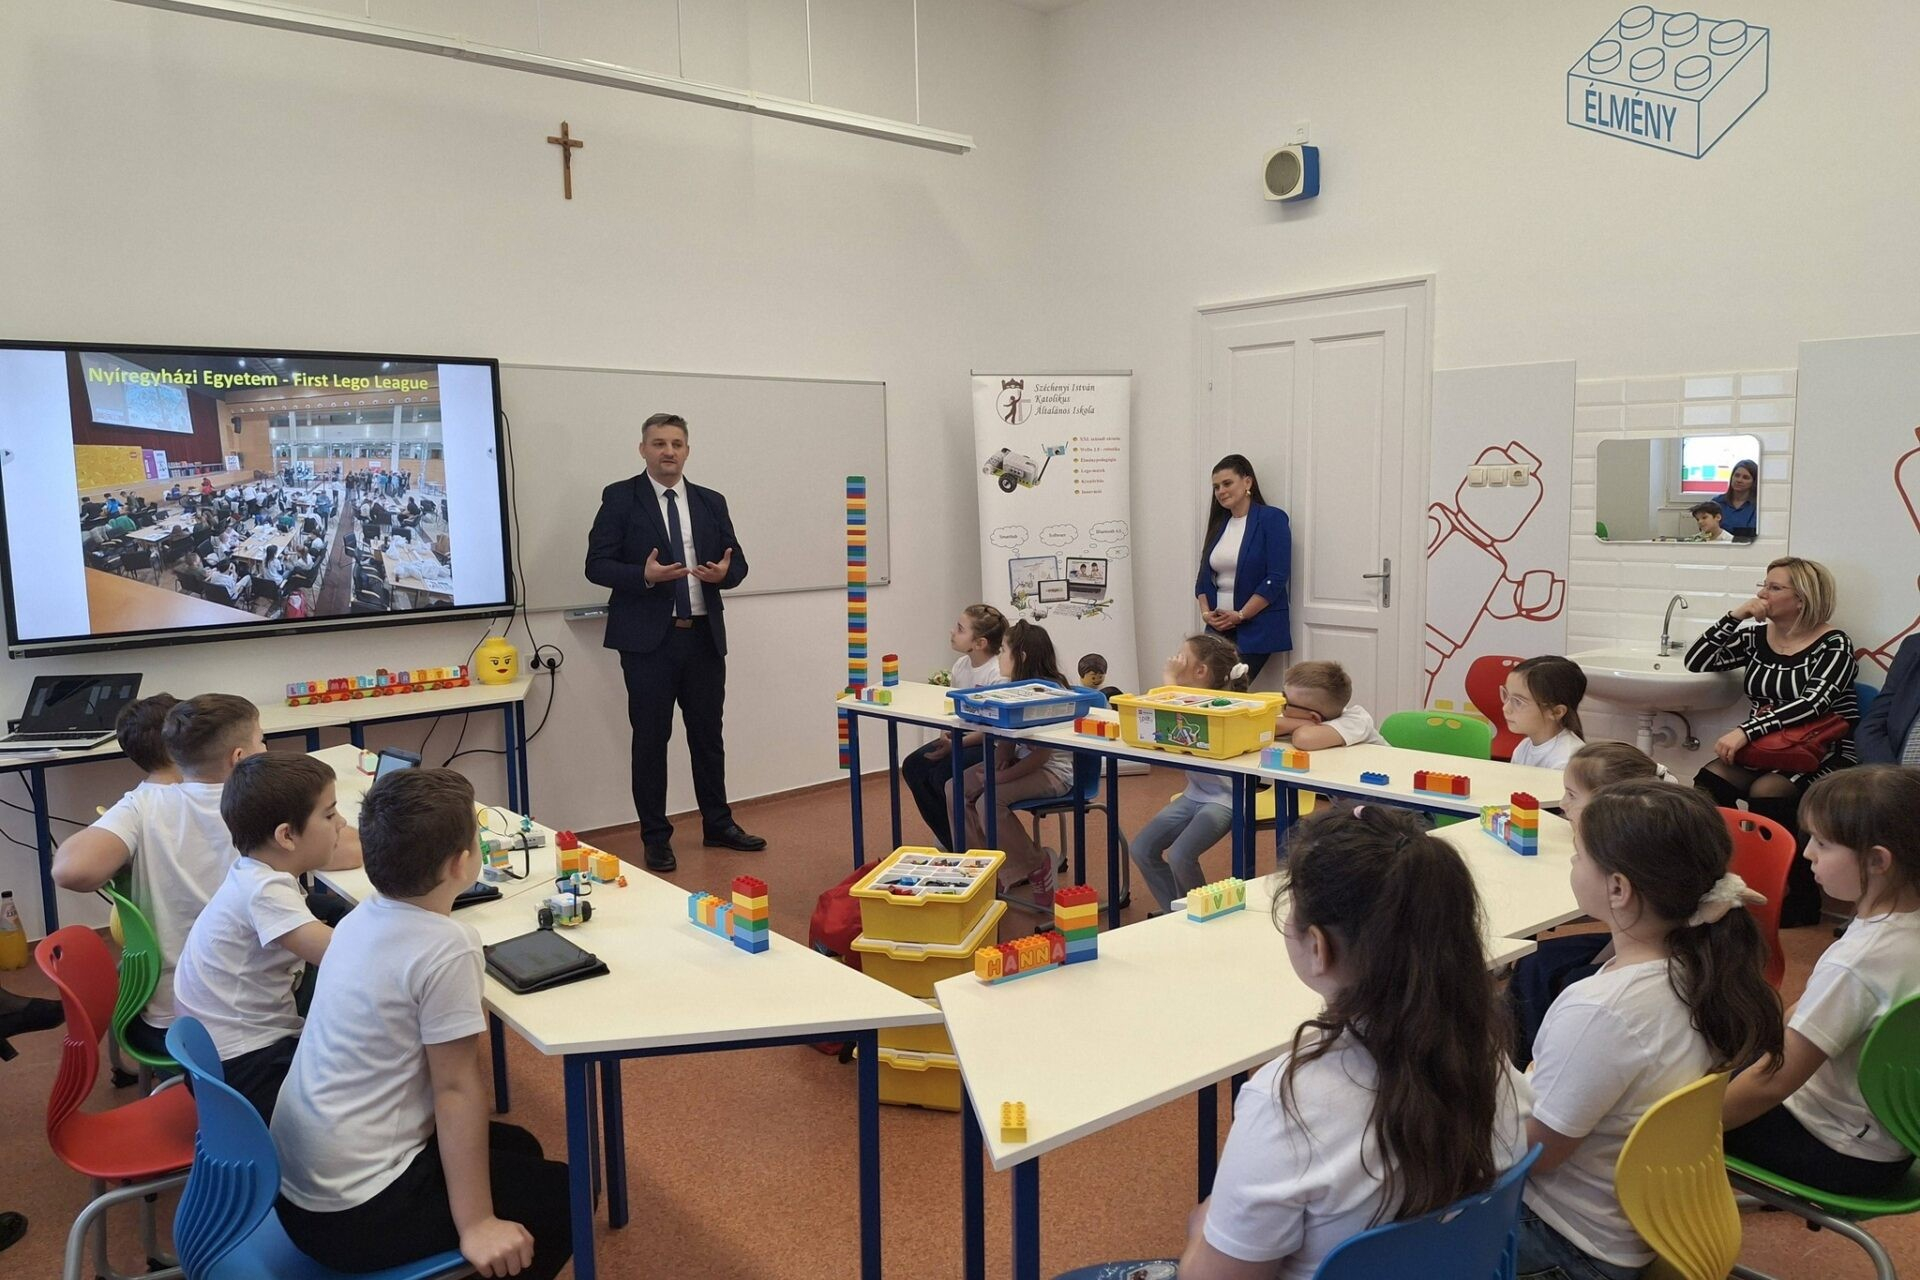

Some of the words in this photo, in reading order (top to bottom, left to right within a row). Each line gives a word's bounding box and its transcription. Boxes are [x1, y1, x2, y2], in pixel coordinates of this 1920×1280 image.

[1585, 81, 1677, 143] ÉLMÉNY
[88, 366, 198, 387] Nyíregyházi
[203, 370, 278, 389] Egyetem
[293, 372, 329, 387] First
[333, 374, 370, 391] Lego
[375, 375, 429, 393] League
[1034, 382, 1070, 394] Széchenyi
[1072, 383, 1095, 392] István
[1034, 393, 1070, 405] Katolikus
[1034, 405, 1070, 416] Általános
[1072, 405, 1095, 416] Iskola
[987, 942, 1065, 977] HANNA
